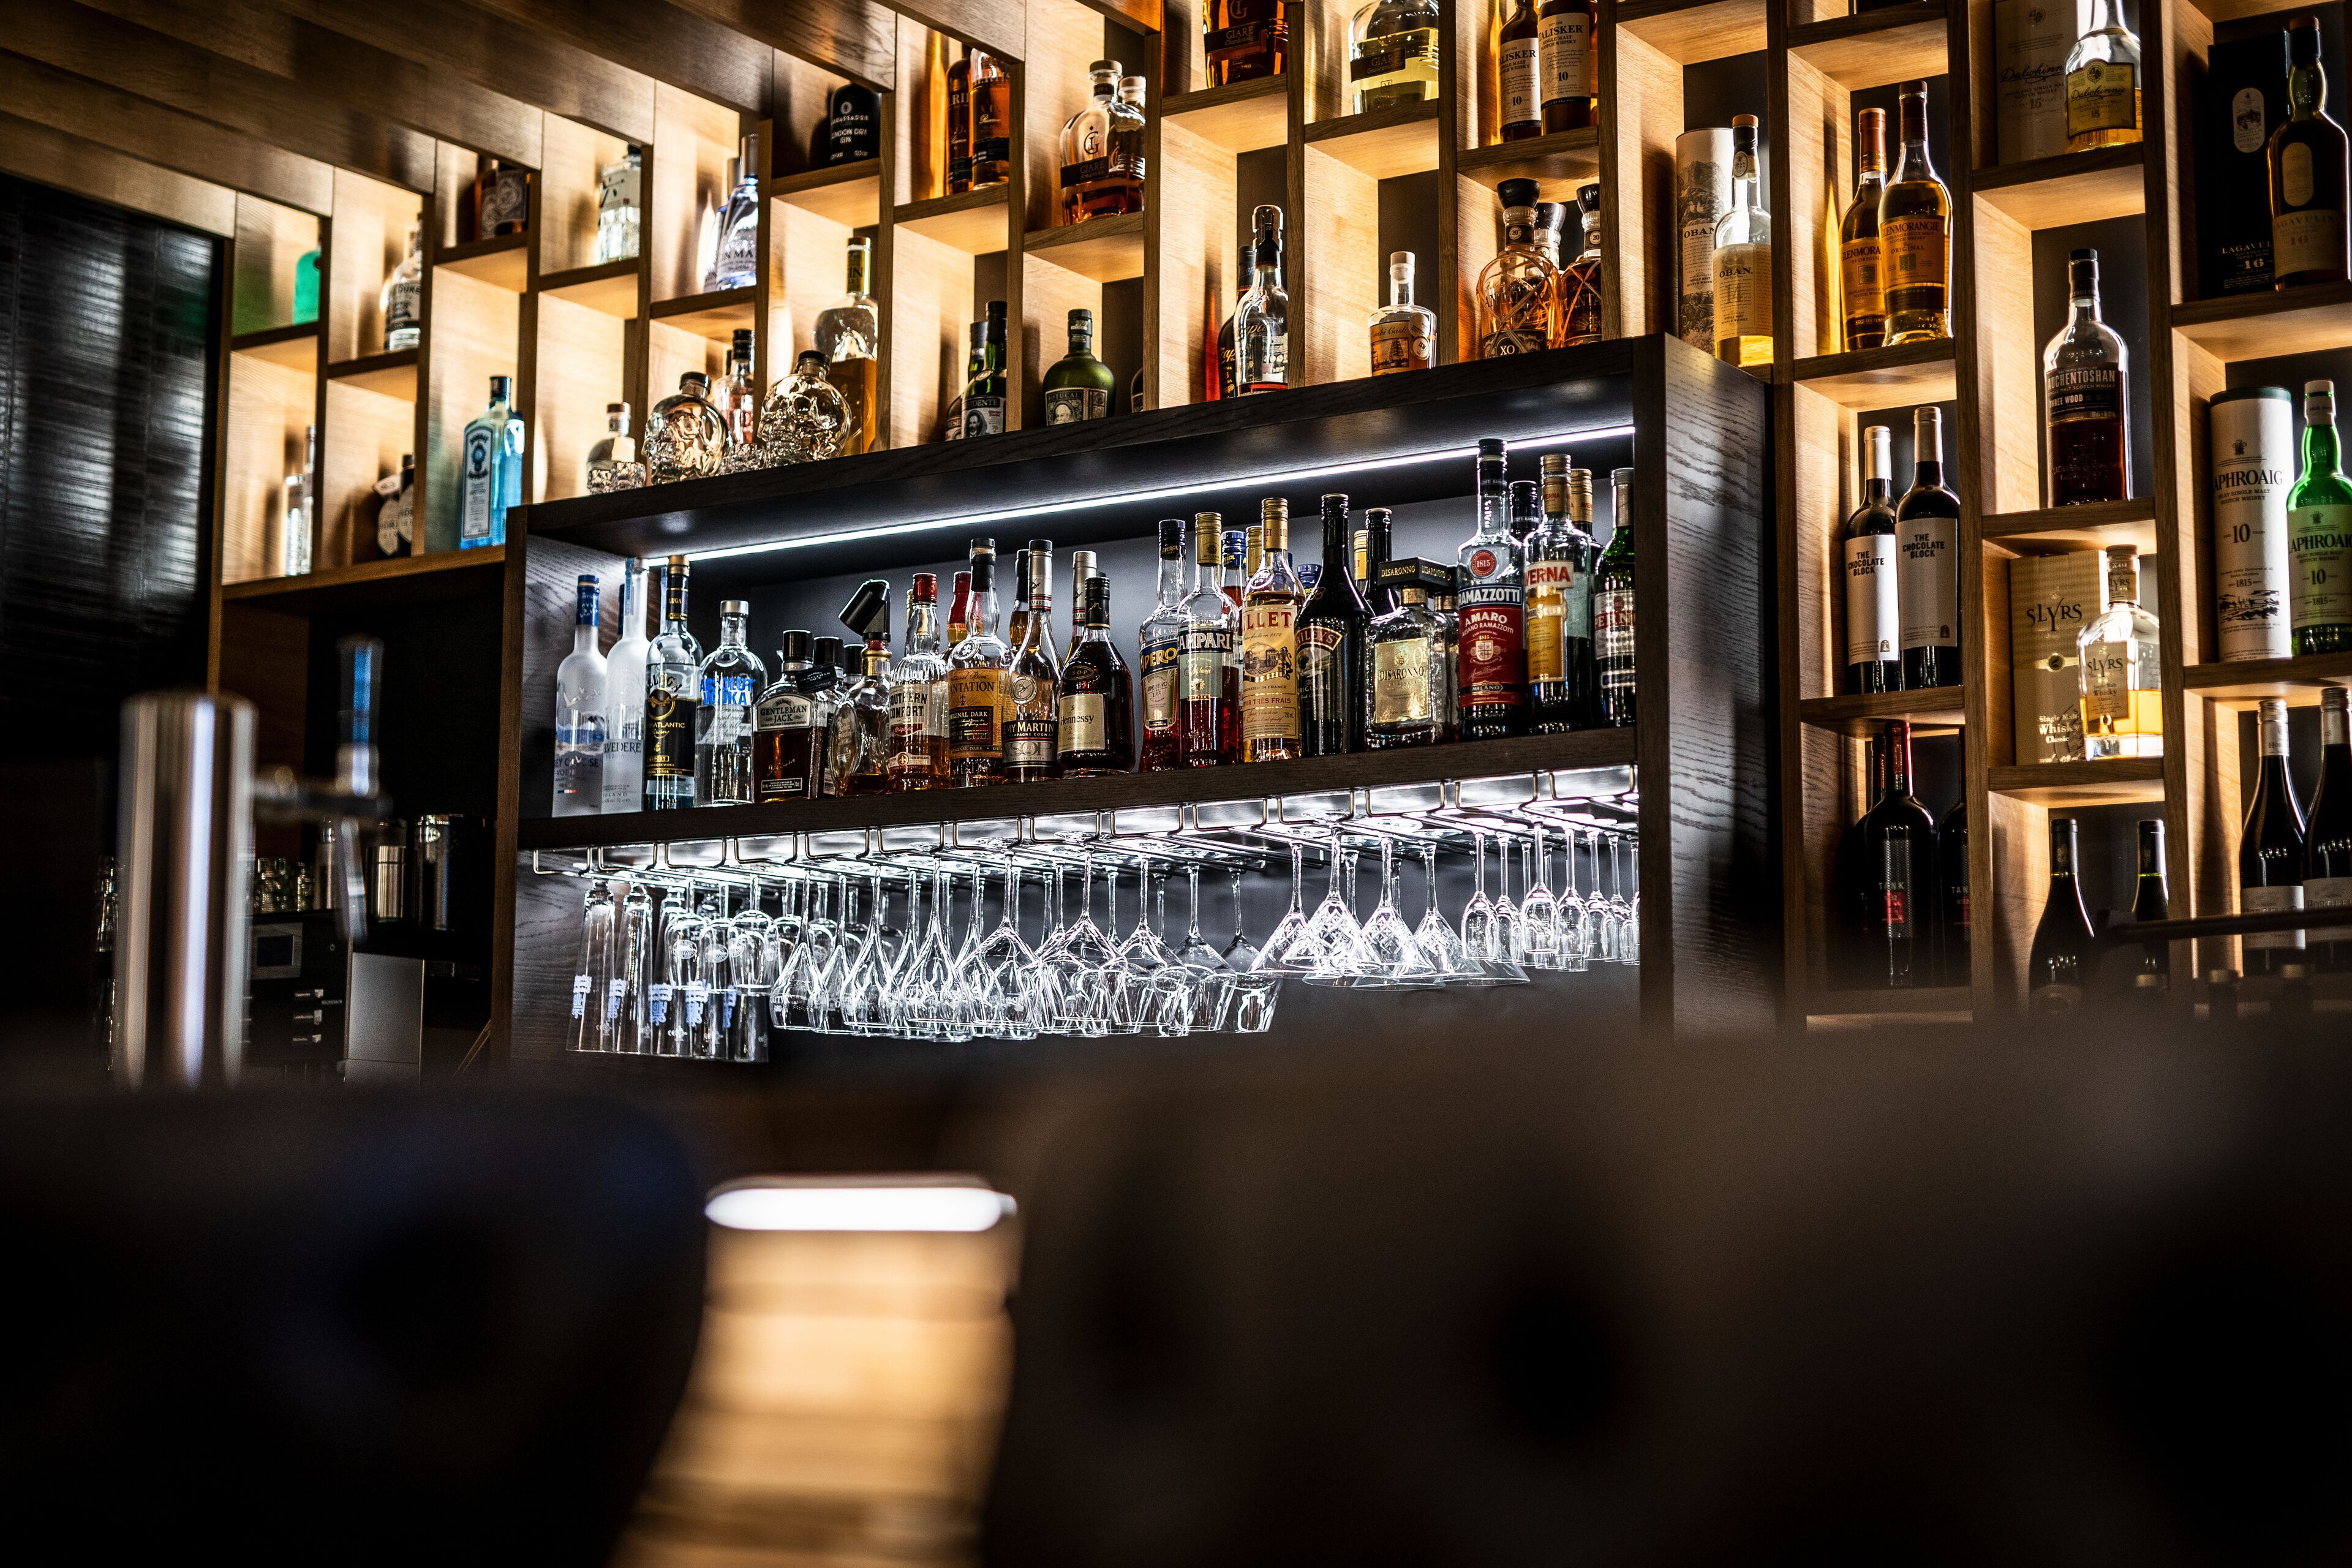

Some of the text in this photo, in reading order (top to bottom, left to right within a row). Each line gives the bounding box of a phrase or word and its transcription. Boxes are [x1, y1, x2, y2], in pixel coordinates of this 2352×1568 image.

[1538, 24, 1583, 42] TALISKER
[1558, 71, 1569, 81] 10
[2070, 85, 2127, 102] Dalwhinnie
[1512, 96, 1522, 106] 10
[2029, 98, 2042, 109] 15
[2090, 110, 2100, 118] 15
[1891, 245, 1925, 254] ORIGINAL
[2244, 257, 2264, 270] 16
[1719, 267, 1752, 278] OBAN
[1500, 345, 1515, 356] XO
[2048, 369, 2116, 390] AUCHENTOSHAN
[2064, 394, 2083, 404] WOOD
[1914, 533, 1929, 542] THE
[2232, 523, 2252, 544] 10
[1161, 544, 1178, 553] APEROL
[1902, 541, 1945, 552] CHOCOLATE
[1856, 551, 1870, 560] THE
[1910, 549, 1936, 559] BLOCK
[1476, 559, 1491, 568] 1815
[1848, 557, 1885, 570] CHOCOLATE
[1381, 565, 1416, 578] DISARONNO
[1853, 566, 1875, 576] BLOCK
[2310, 568, 2327, 585] 10
[2236, 578, 2253, 588] 1815
[1458, 589, 1520, 606] RAMAZZOTTI
[1464, 612, 1508, 628] AMARO
[2026, 597, 2082, 632] SLYRS
[1479, 622, 1514, 635] RAMAZZOTTI
[2087, 653, 2124, 679] SLYRS
[1379, 665, 1425, 681] DISARONNO
[700, 676, 753, 692] ABSOLUT
[2094, 688, 2117, 697] Whisky
[704, 692, 747, 705] VODKA
[1253, 696, 1269, 706] TRÈS
[760, 705, 807, 716] GENTLEMAN
[890, 706, 925, 719] COMFORT
[774, 714, 794, 723] JACK
[1060, 714, 1095, 726] Hennessy
[2038, 715, 2060, 723] Single
[1017, 721, 1054, 733] MARTIN
[2038, 723, 2081, 735] Whisky
[2045, 736, 2070, 744] Classic
